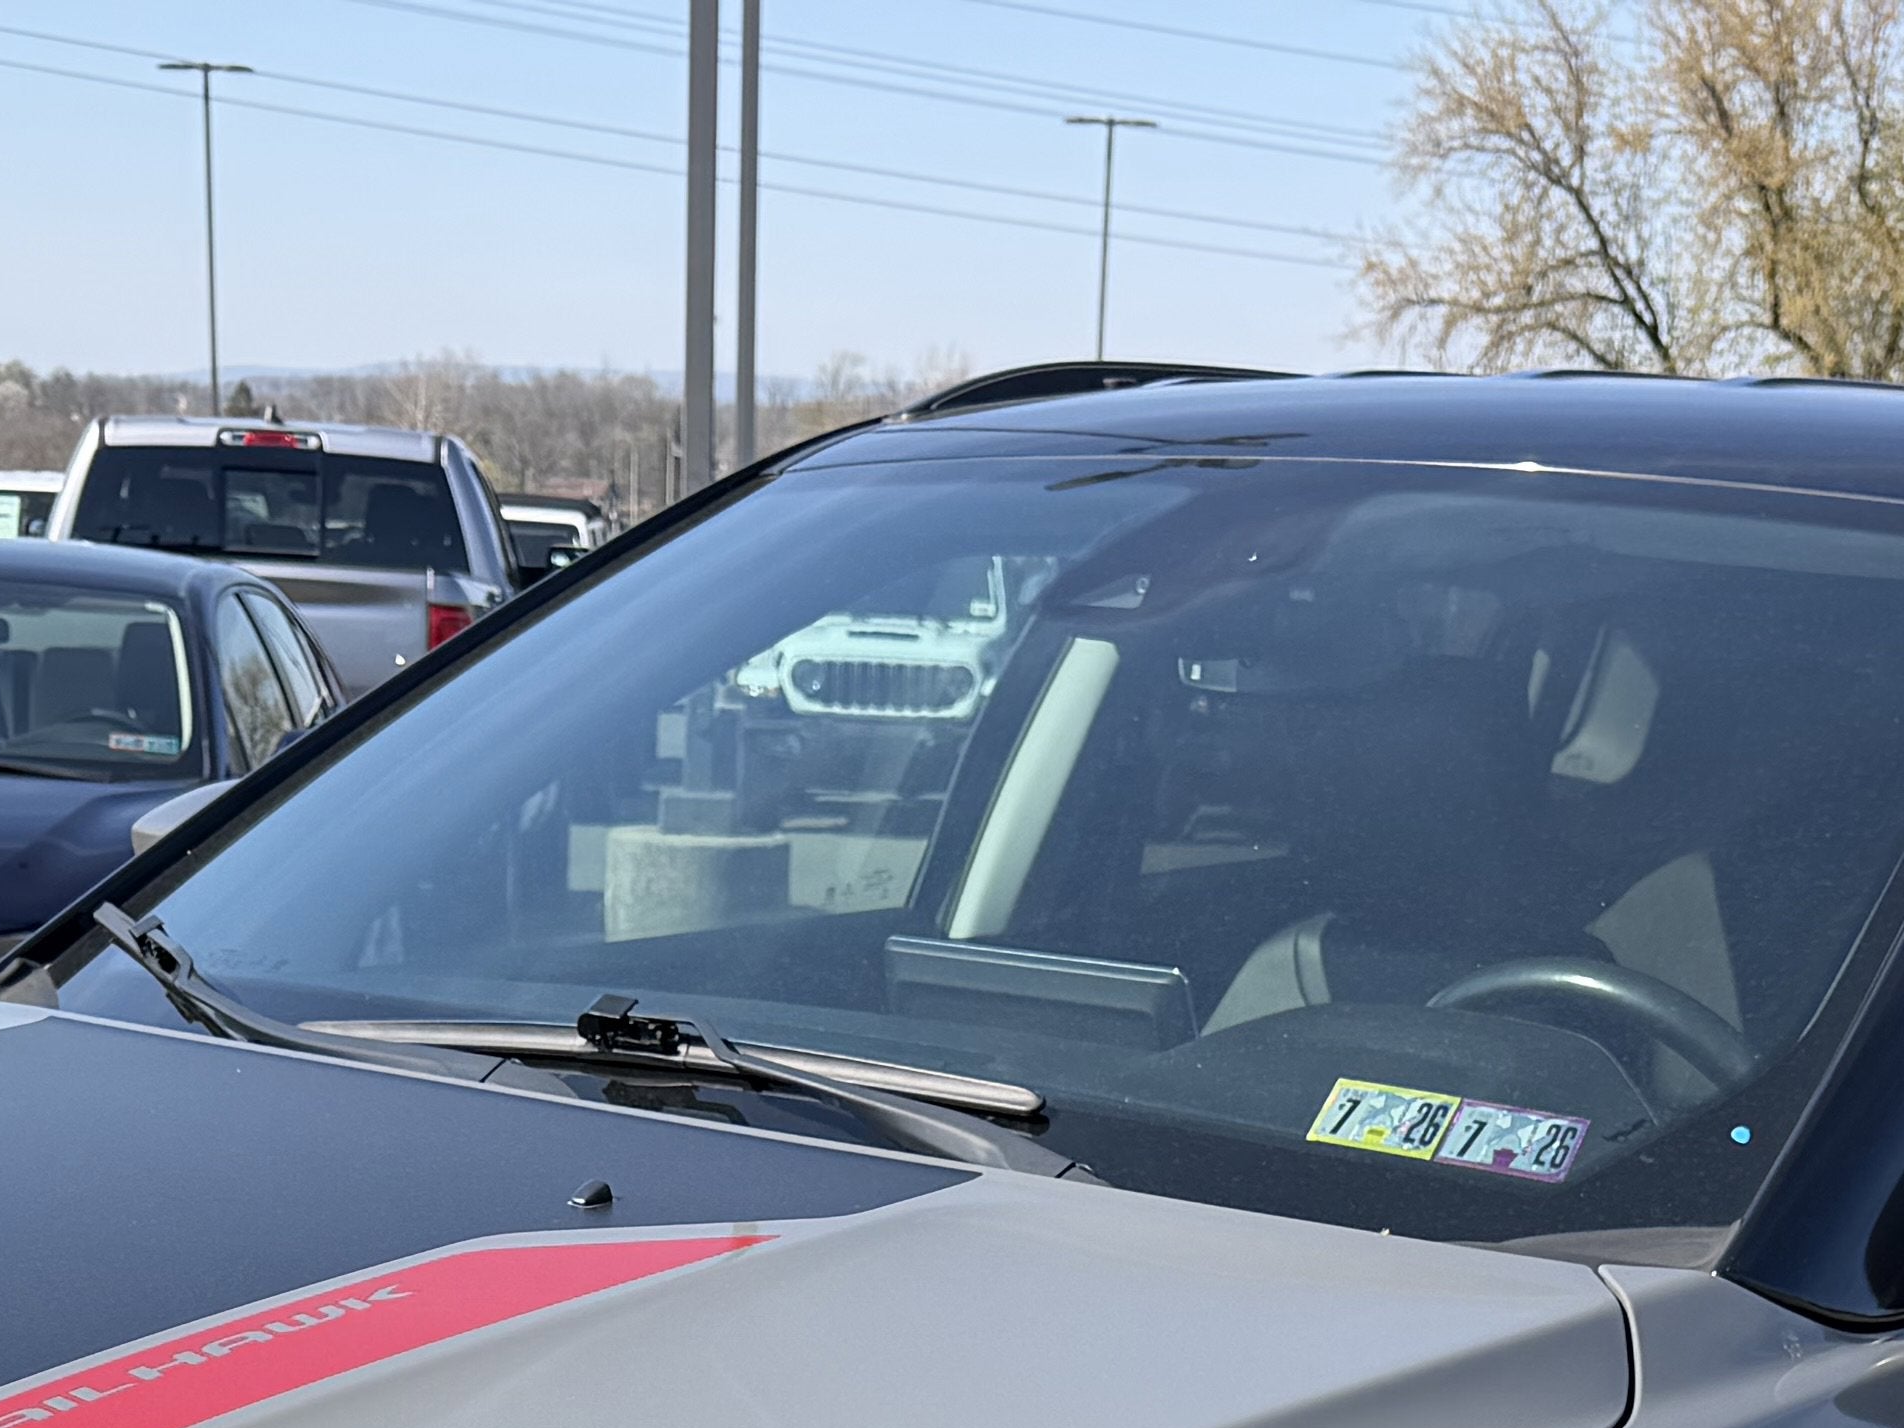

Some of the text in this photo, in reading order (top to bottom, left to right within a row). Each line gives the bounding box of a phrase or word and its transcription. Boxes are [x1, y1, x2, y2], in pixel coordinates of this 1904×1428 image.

[1329, 1097, 1449, 1147] 7 26
[1456, 1119, 1578, 1169] 7 26
